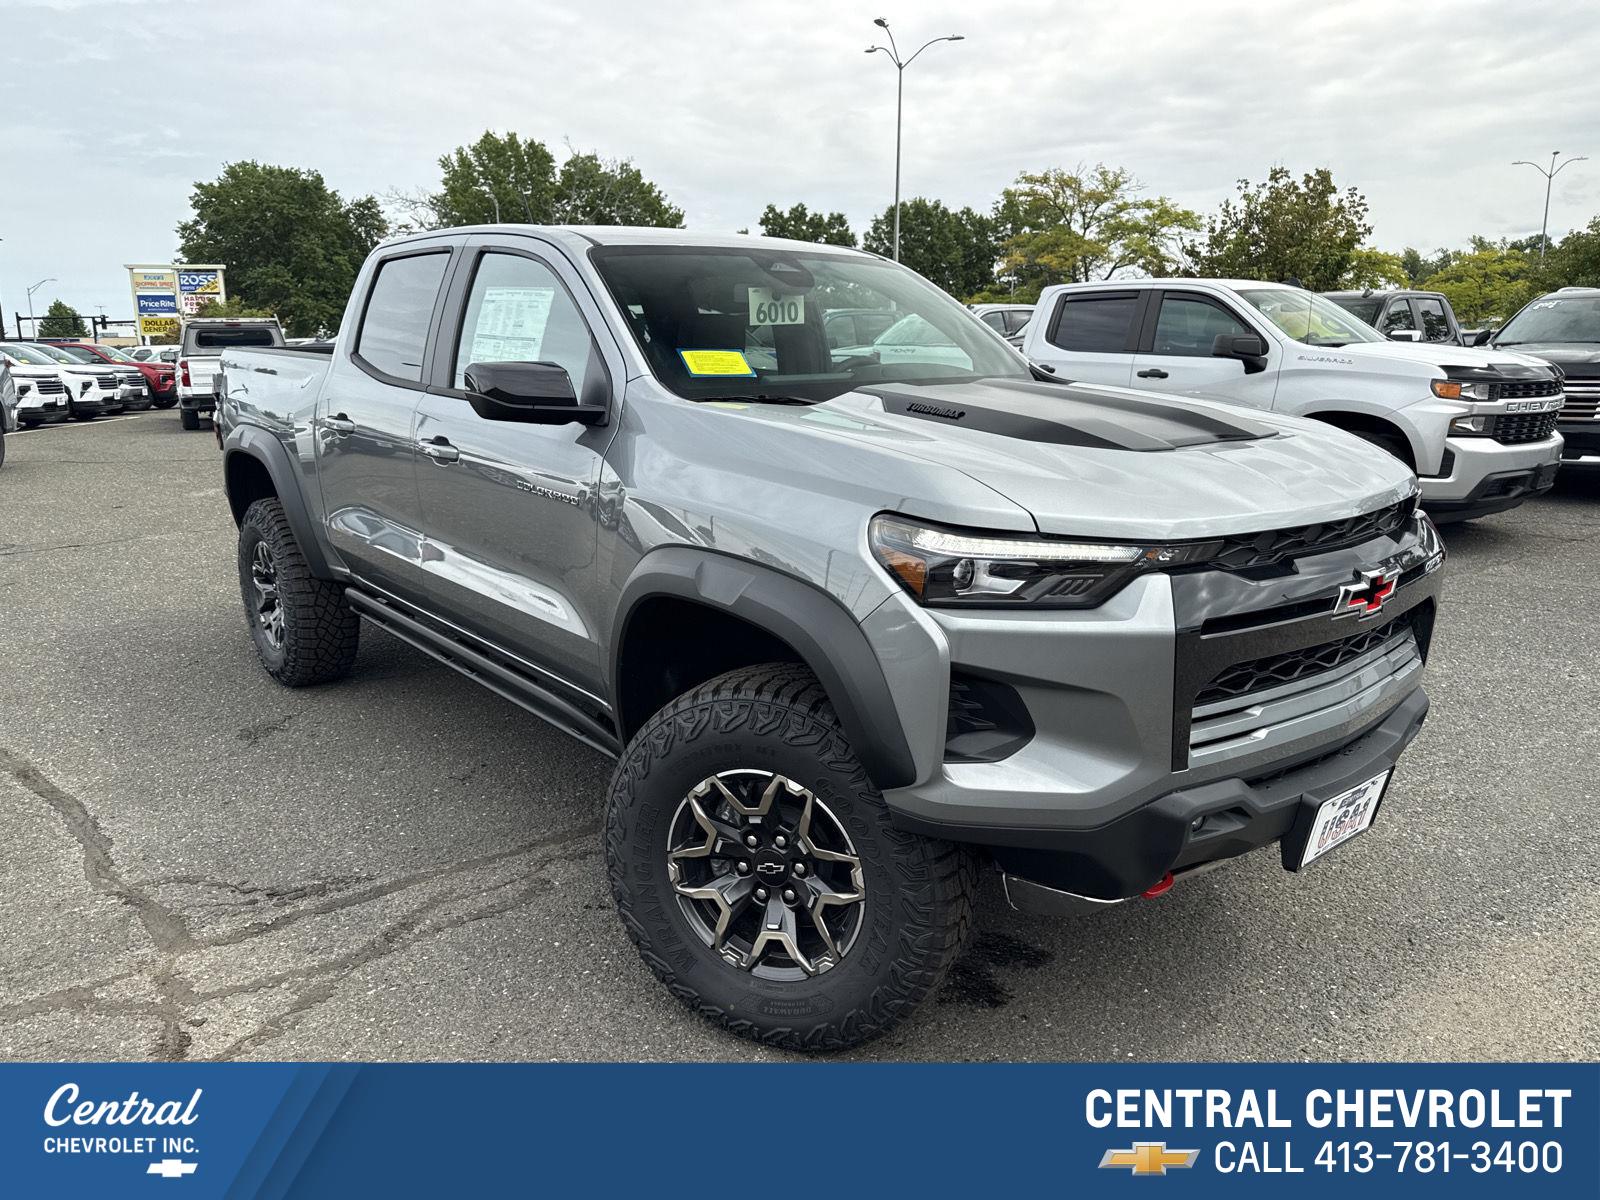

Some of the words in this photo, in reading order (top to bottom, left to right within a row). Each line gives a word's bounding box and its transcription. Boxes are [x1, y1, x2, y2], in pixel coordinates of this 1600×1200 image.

[180, 275, 216, 285] ROSS
[140, 299, 159, 308] Price
[160, 299, 175, 308] Rite
[756, 302, 798, 323] 6010
[516, 480, 580, 505] COLORADO
[633, 801, 698, 974] WRANGLER
